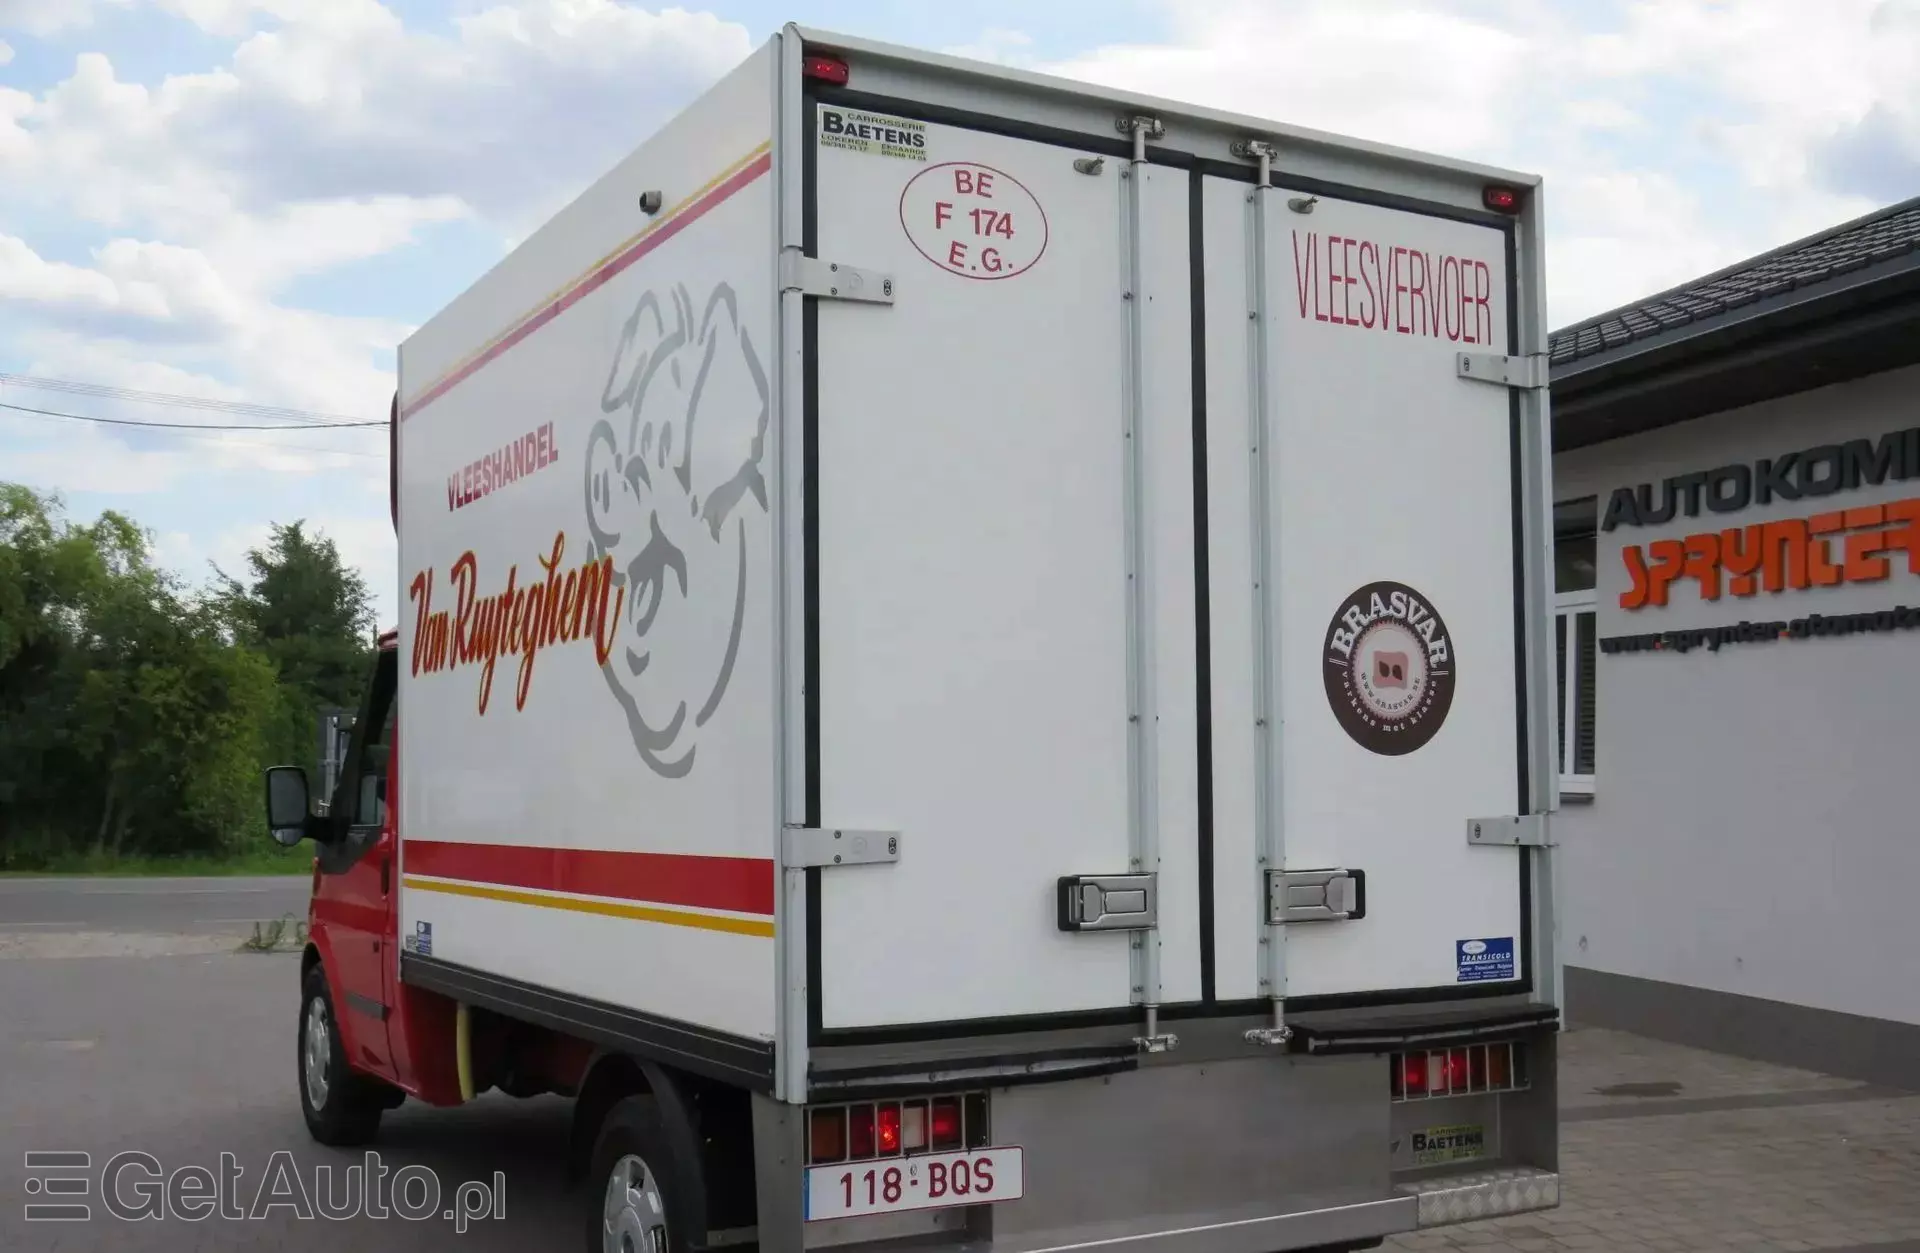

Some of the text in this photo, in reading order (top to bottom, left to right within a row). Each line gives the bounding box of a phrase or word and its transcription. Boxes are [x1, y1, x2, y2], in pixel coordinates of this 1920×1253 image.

[823, 111, 925, 148] BAETENS
[847, 113, 925, 132] CARROSSERIE
[954, 169, 994, 199] BE
[935, 201, 1014, 240] F 174
[948, 240, 1013, 273] E.G.
[1292, 229, 1492, 346] VLEESVERVOER
[446, 420, 559, 512] VLEESHANDEL
[410, 530, 625, 717] Van Ruyteghem
[1331, 590, 1448, 669] BRASVAR
[1382, 722, 1406, 732] met
[1461, 952, 1512, 962] TRANSICOLD
[1412, 1132, 1484, 1153] BAETENS
[840, 1157, 995, 1209] 118-BQS
